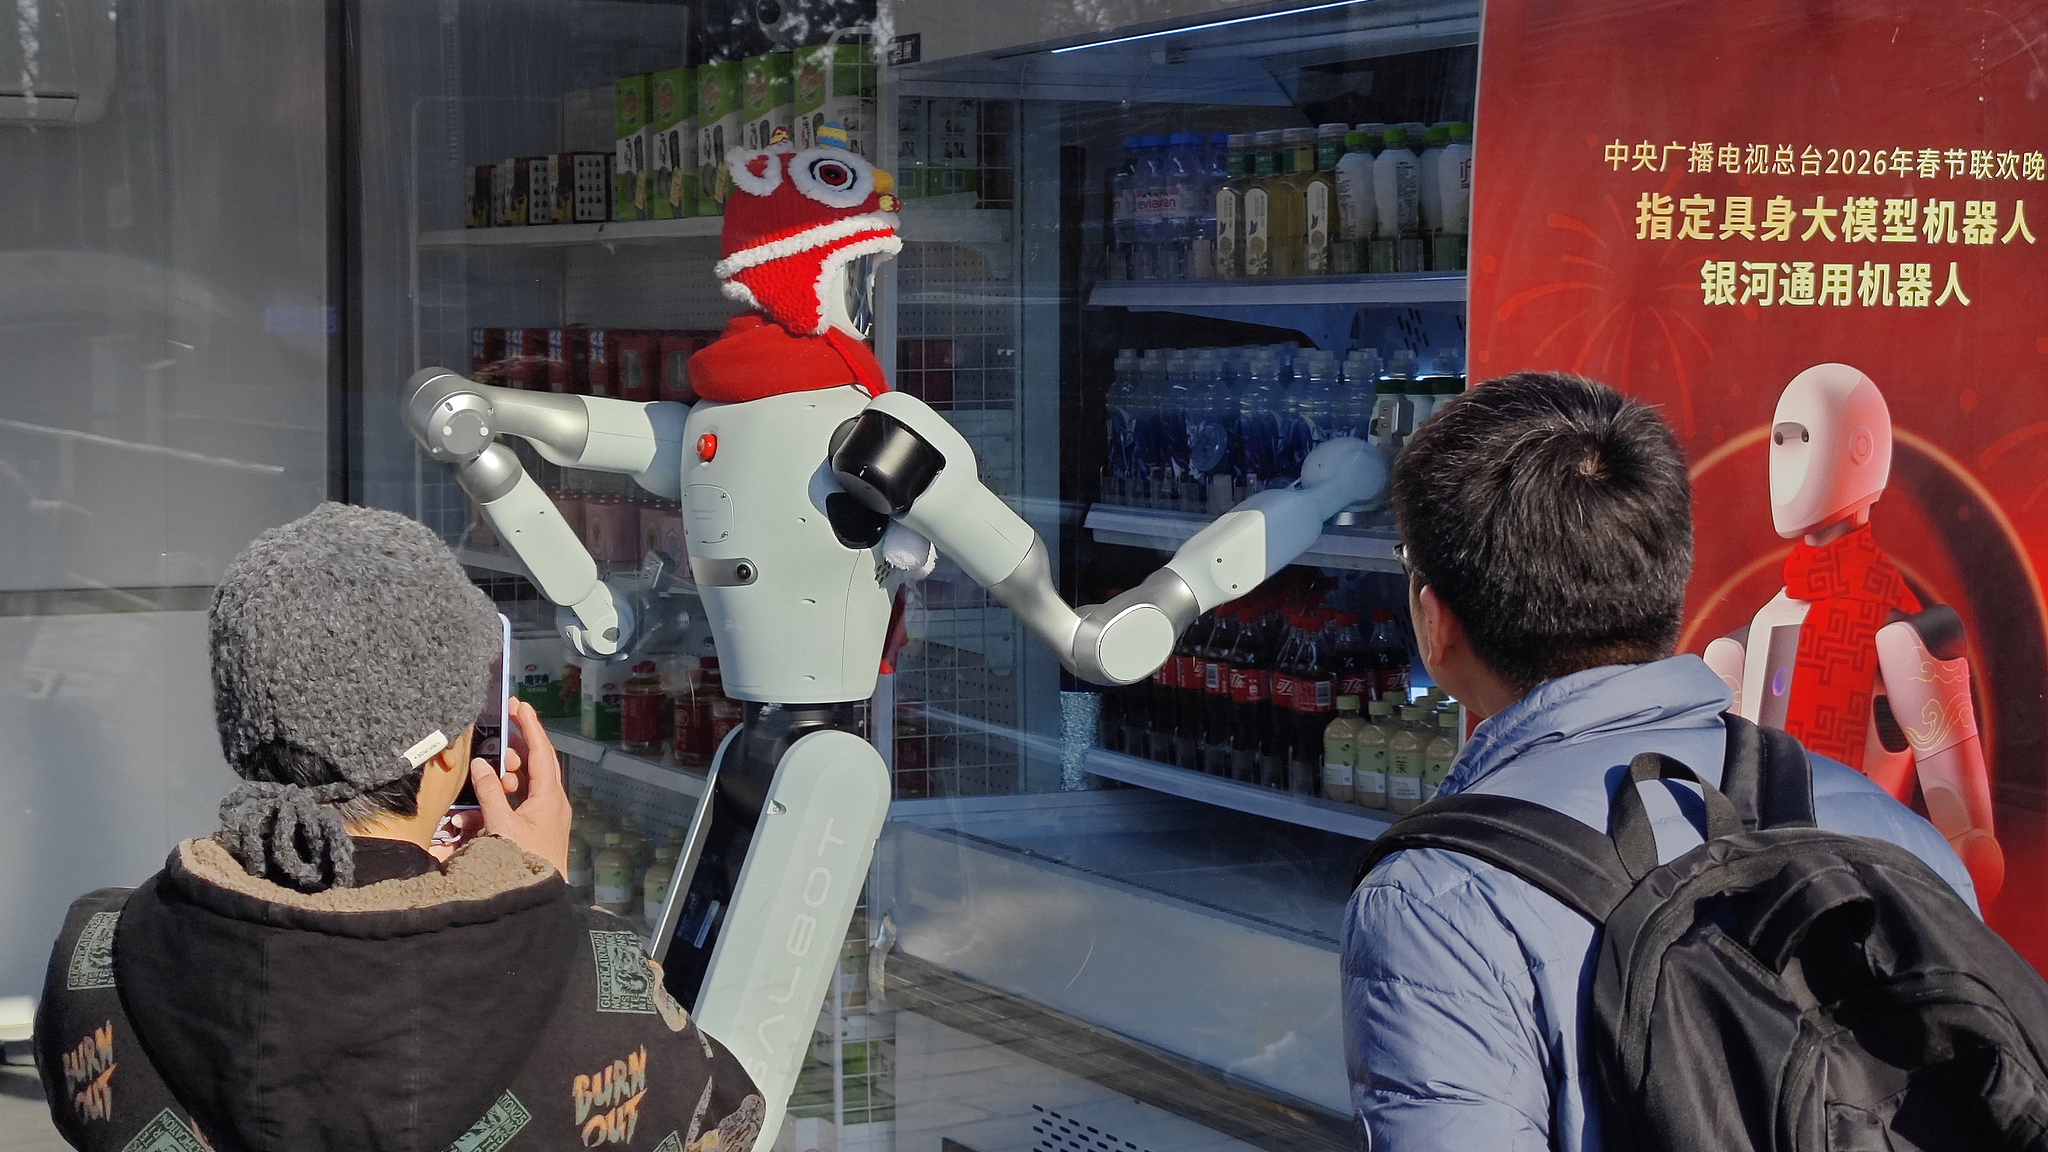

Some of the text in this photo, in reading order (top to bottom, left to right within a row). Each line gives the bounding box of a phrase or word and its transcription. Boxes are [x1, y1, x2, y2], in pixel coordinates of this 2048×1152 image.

[1603, 138, 2046, 182] 中央广播电视总台2026年春节联欢晚
[1635, 193, 2037, 246] 指定具身大模型机器人
[1701, 260, 1971, 307] 银河通用机器人
[572, 1043, 648, 1126] BURN
[581, 1087, 648, 1148] OUT
